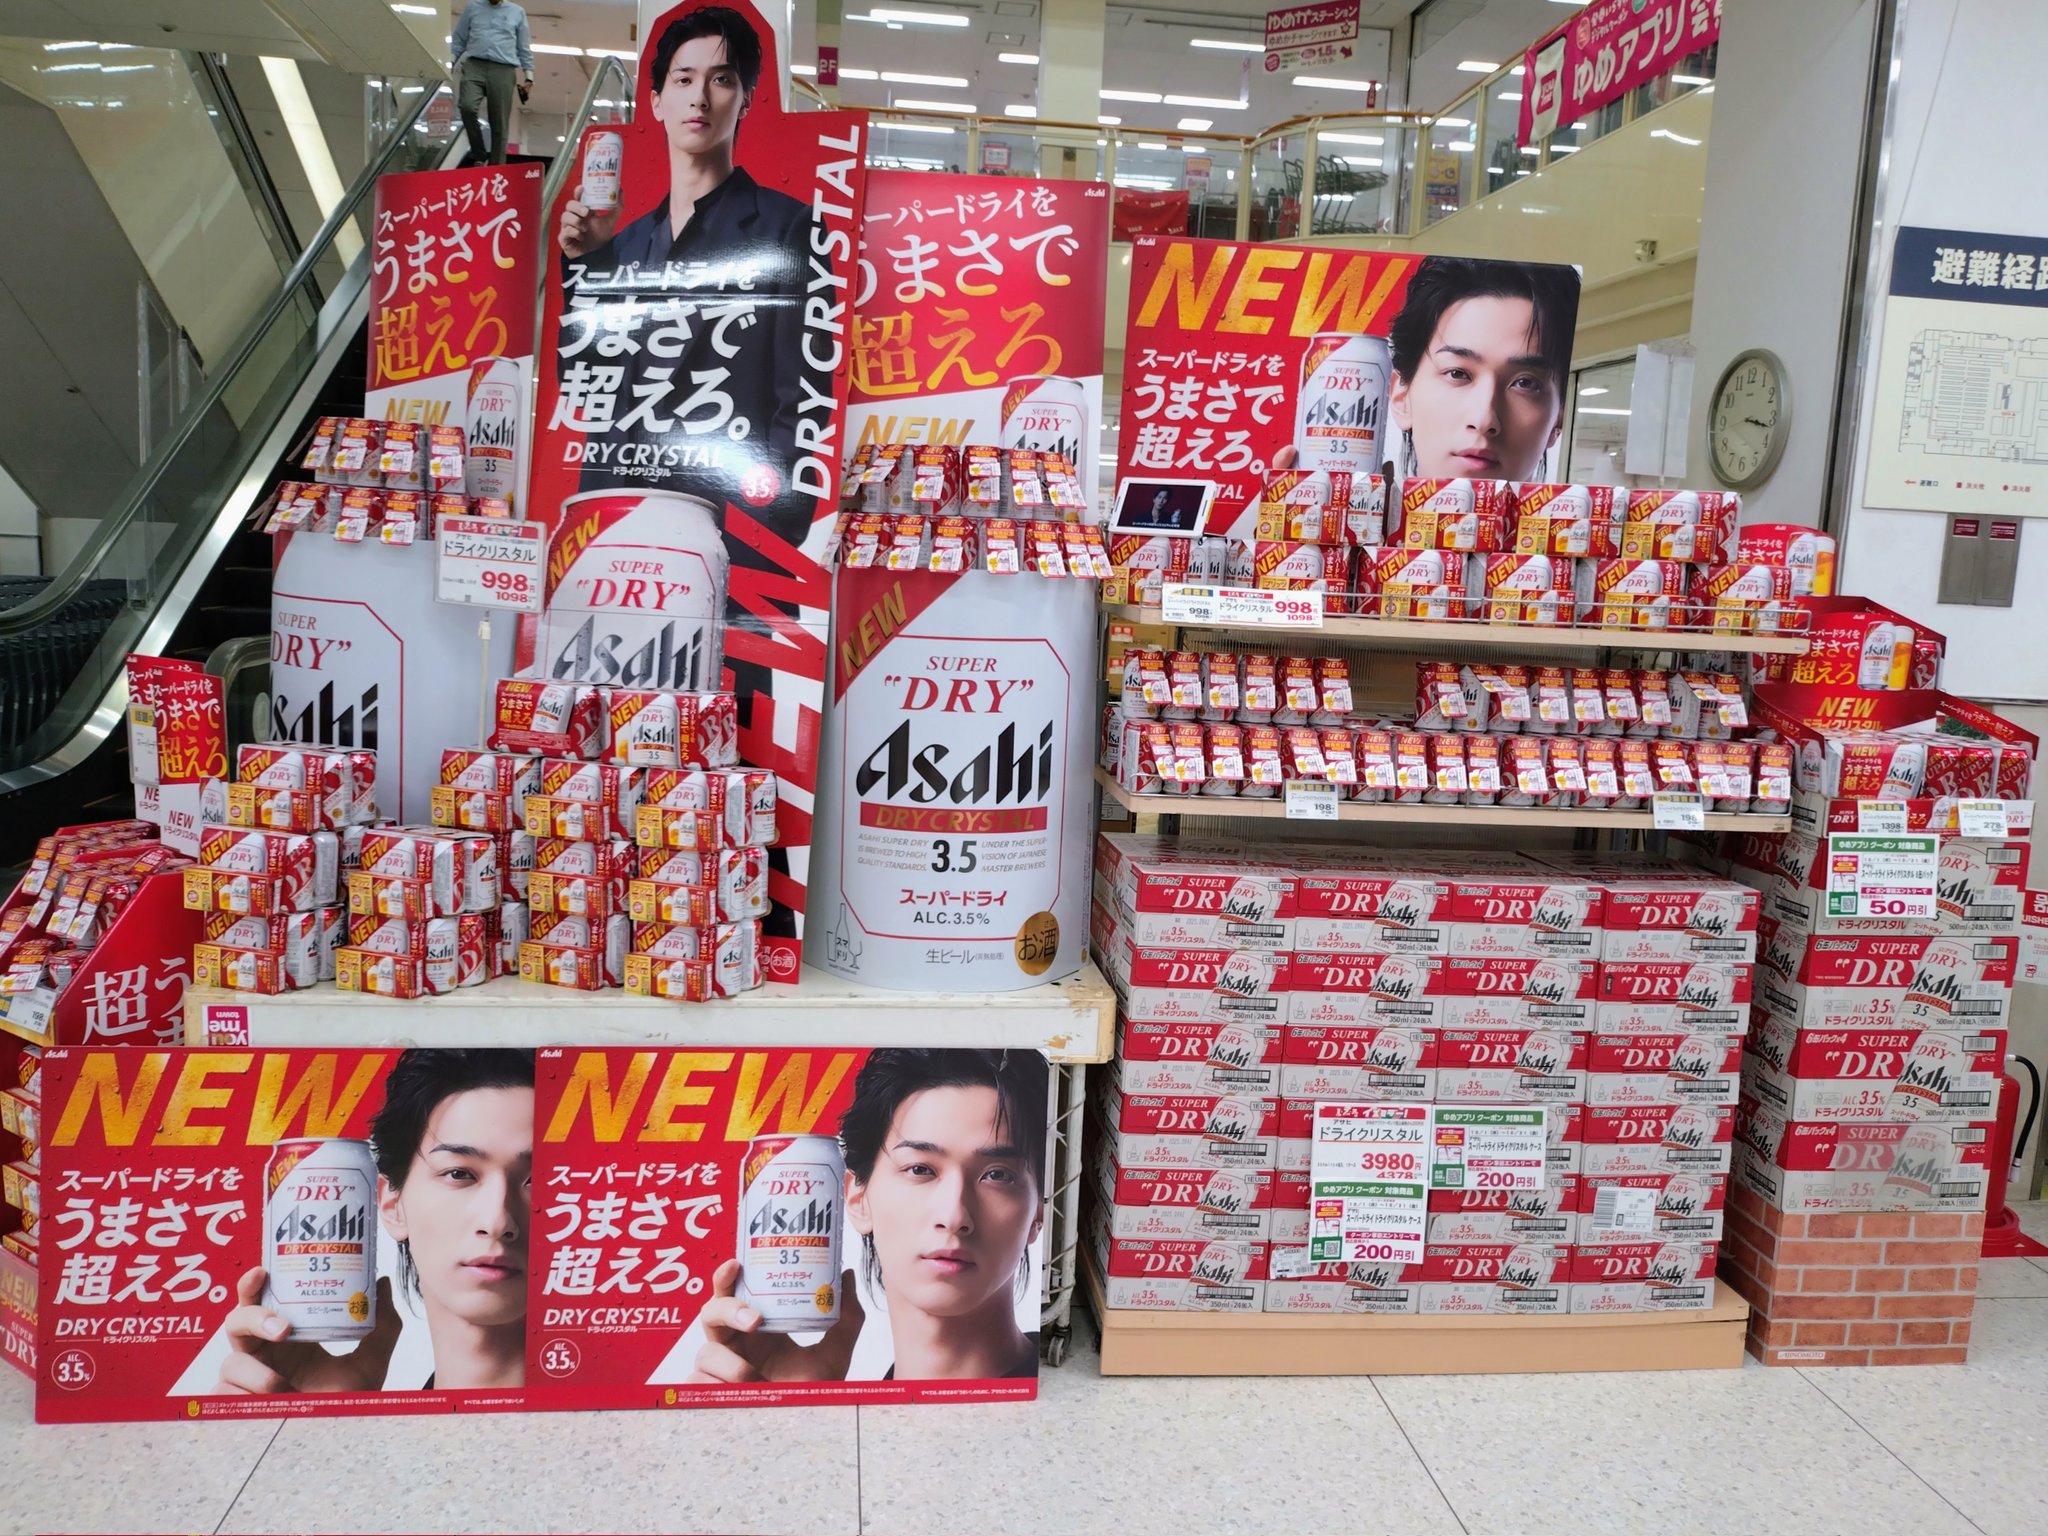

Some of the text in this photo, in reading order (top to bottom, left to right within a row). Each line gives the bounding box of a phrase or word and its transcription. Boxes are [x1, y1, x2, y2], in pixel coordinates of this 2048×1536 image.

[378, 173, 509, 235] スーパードライを
[860, 186, 1058, 233] ーパードライを
[374, 208, 522, 304] うまさで
[1135, 242, 1411, 338] NEW
[791, 125, 860, 500] DRY CRYSTAL
[557, 295, 757, 359] うまさで
[374, 286, 508, 386] 超えろ
[851, 302, 1063, 396] 超えろ
[1137, 349, 1286, 377] スーパードライを
[1735, 375, 1743, 391] 11
[1747, 367, 1757, 384] 12
[1762, 371, 1767, 387] 1
[547, 361, 751, 442] 超えろ。
[1134, 374, 1285, 425] うまさで
[1725, 392, 1734, 408] 10
[1768, 387, 1775, 403] 2
[1306, 392, 1379, 428] Asahi
[1769, 410, 1777, 426] 3
[1720, 415, 1727, 431] 9
[470, 415, 515, 448] Asahi
[1721, 437, 1728, 453] 8
[1762, 433, 1768, 448] 4
[562, 441, 724, 468] DRY CRYSTAL
[1129, 423, 1265, 475] 超えろ。
[1728, 452, 1735, 468] 7
[1738, 456, 1745, 472] 6
[1751, 451, 1758, 467] 5
[1267, 472, 1298, 501] NEW
[444, 541, 536, 561] ドライクリスタル
[609, 560, 664, 576] SUPER
[481, 571, 528, 591] 998
[495, 592, 528, 602] 1098
[1189, 607, 1209, 615] 998
[1219, 602, 1273, 613] ドライクリスタル
[1275, 601, 1312, 614] 998
[278, 611, 317, 630] SUPER
[841, 580, 907, 677] NEW
[552, 614, 704, 689] Asahi
[1865, 644, 1891, 656] Asahi
[926, 655, 998, 672] SUPER
[1791, 660, 1856, 685] 超えろ
[154, 678, 213, 697] スーパードライを
[506, 682, 532, 692] NEW
[500, 698, 533, 709] うまさで
[611, 695, 643, 728] NEW
[1817, 697, 1879, 718] NEW
[153, 698, 221, 733] うまさで
[272, 680, 378, 750] sahi
[500, 709, 532, 725] 超えろ
[632, 721, 675, 745] Asahi
[159, 735, 227, 779] 超えろ
[1851, 746, 1881, 756] NEW
[856, 718, 1053, 804] Asahi
[1844, 765, 1882, 775] うまさで
[1886, 768, 1917, 784] Asahi
[1843, 776, 1880, 790] 超えろ
[169, 810, 194, 829] NEW
[876, 807, 1034, 832] DRY CRYSTAL
[1881, 822, 1901, 830] 1398
[858, 833, 929, 847] ASAHI SUPER DRY
[981, 839, 1025, 848] UNDER THE
[1838, 841, 1870, 850] ゆめアプリ
[1870, 842, 1896, 850] クーポン
[931, 839, 978, 873] 3.5
[981, 852, 1005, 860] VISION
[981, 864, 1013, 873] MASTER
[1188, 877, 1226, 888] SUPER
[900, 889, 1008, 906] スーパードライ
[1870, 900, 1928, 916] 50 円引
[1837, 920, 1907, 930] ドライクリスタル
[1017, 927, 1058, 962] お酒
[1160, 936, 1206, 944] ドライクリスタル
[1868, 942, 1921, 955] SUPER
[925, 949, 975, 965] 生ビール
[32, 1010, 44, 1022] 198
[216, 1011, 240, 1019] town
[1824, 1015, 1894, 1026] ドライクリスタル
[208, 1020, 241, 1032] me
[541, 1050, 562, 1058] Asahi
[50, 1053, 387, 1146] NEW
[542, 1053, 857, 1142] NEW
[1443, 1113, 1534, 1123] ゆめアプリ クーポン 対象商品
[1320, 1126, 1423, 1141] ドライクリスタル
[744, 1147, 773, 1184] NEW
[1361, 1153, 1414, 1170] 3980
[269, 1152, 300, 1189] NEW
[547, 1162, 721, 1186] スーパードライを
[779, 1170, 809, 1178] SUPER
[56, 1167, 244, 1192] スーパードライを
[306, 1175, 339, 1184] SUPER
[1476, 1172, 1536, 1187] 200 円引
[1322, 1185, 1413, 1196] ゆめアプリ クーポン 対象商品
[54, 1197, 247, 1250] うまさで
[275, 1204, 365, 1242] Asahi
[545, 1192, 723, 1242] うまさで
[750, 1199, 831, 1236] Asahi
[284, 1243, 356, 1254] DRY CRYSTAL
[757, 1237, 825, 1247] DRY CRYSTAL
[779, 1250, 800, 1265] 3.5
[1354, 1244, 1415, 1261] 200 円引
[309, 1256, 331, 1272] 3.5
[542, 1245, 704, 1295] 超えろ。
[53, 1252, 228, 1305] 超えろ。
[295, 1279, 344, 1288] スーパードライ
[766, 1272, 812, 1280] スーパードライ
[543, 1307, 682, 1325] DRY CRYSTAL
[55, 1316, 205, 1336] DRY CRYSTAL
